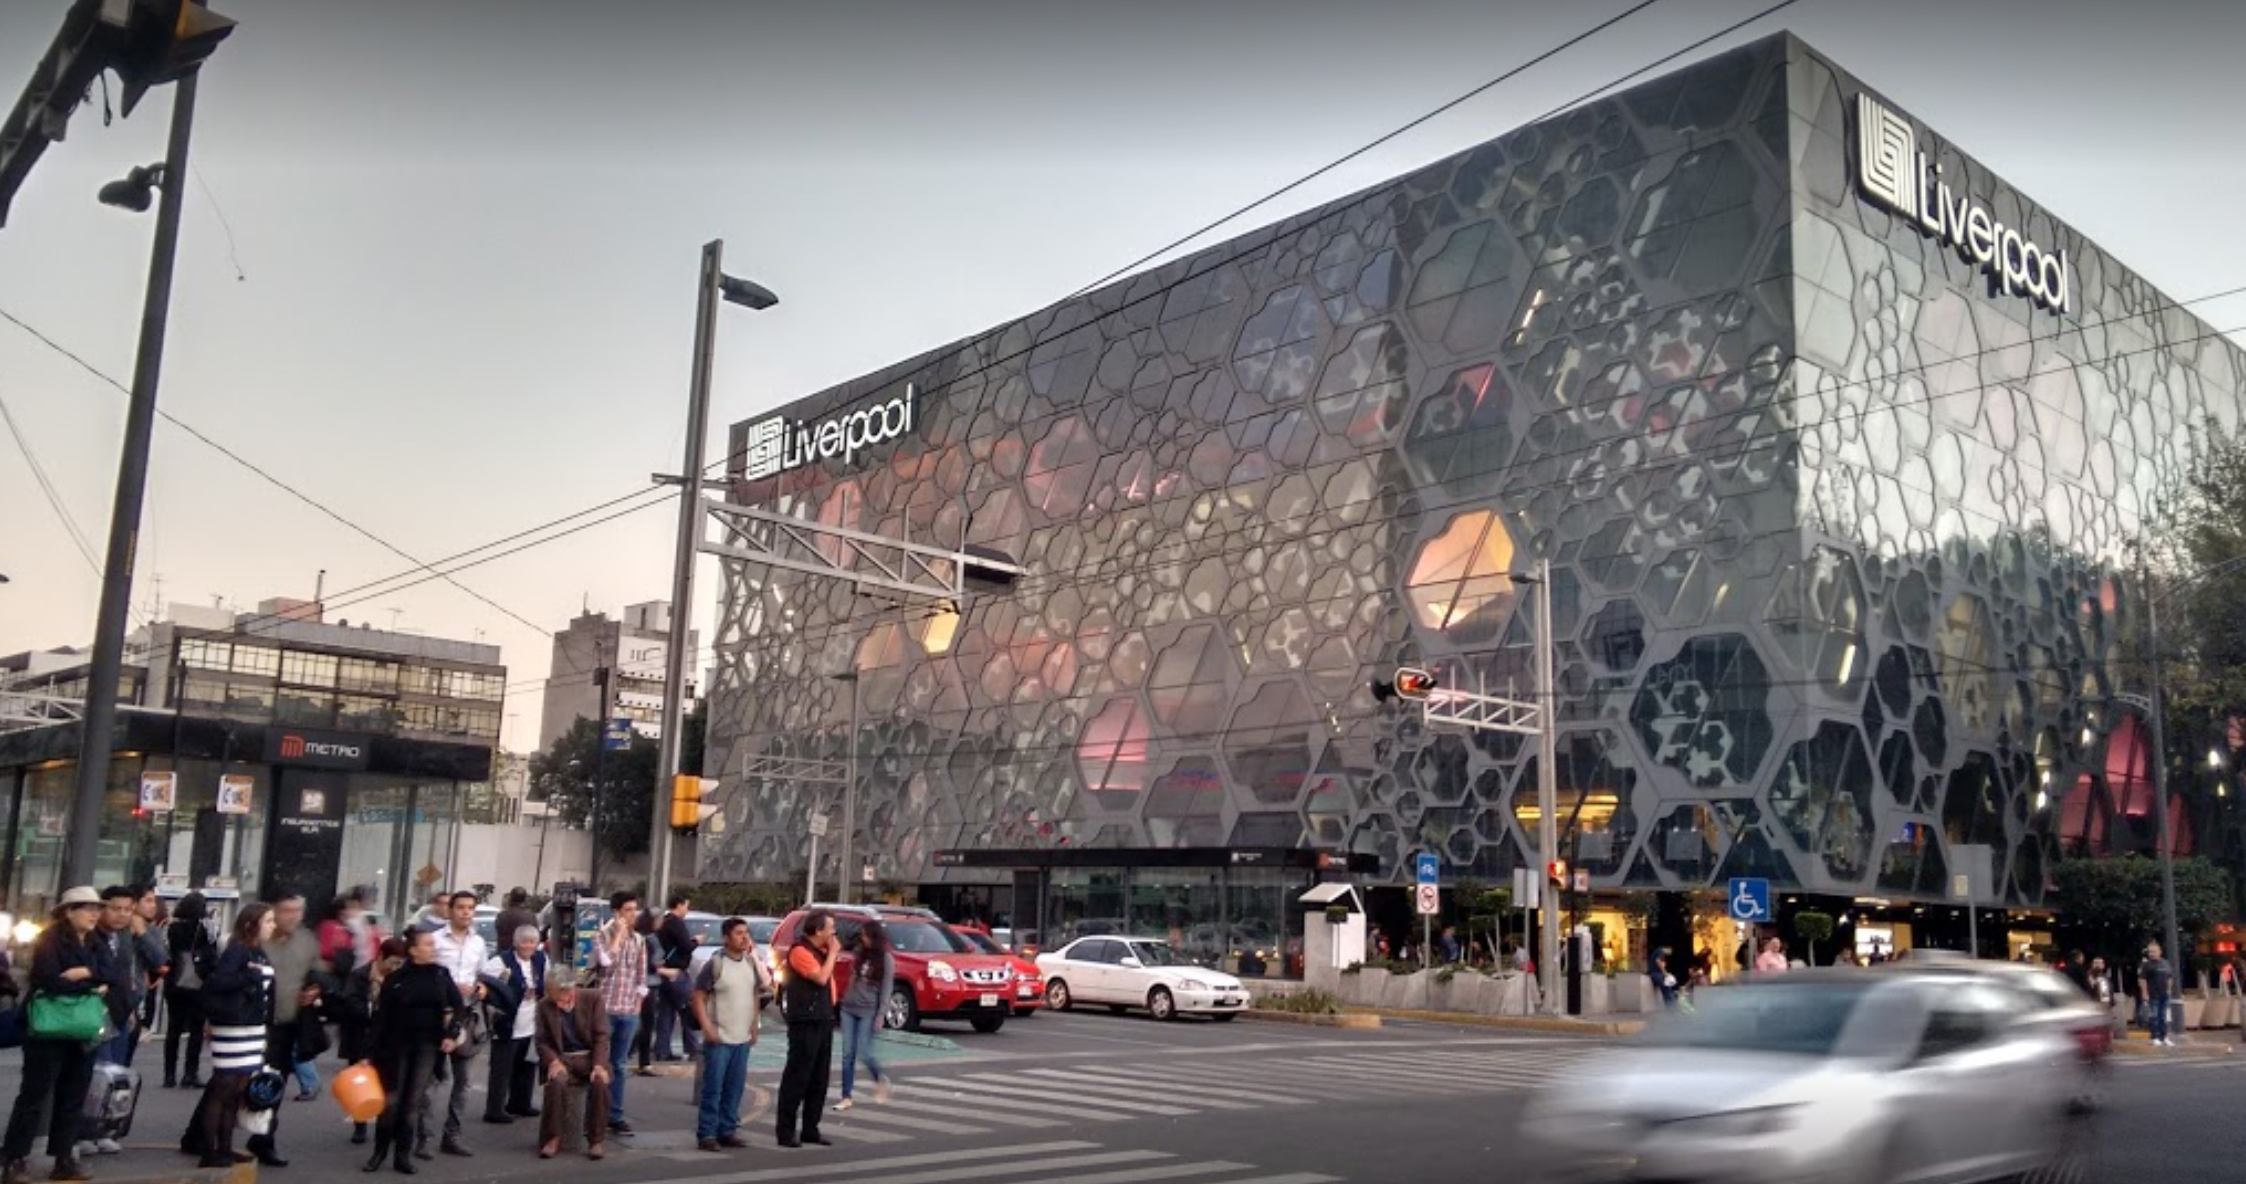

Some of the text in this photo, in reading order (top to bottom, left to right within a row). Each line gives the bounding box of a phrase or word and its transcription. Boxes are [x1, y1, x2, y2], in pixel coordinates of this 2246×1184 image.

[1918, 151, 2070, 313] Liverpool
[783, 382, 914, 469] Liverpool
[305, 742, 361, 757] METRO
